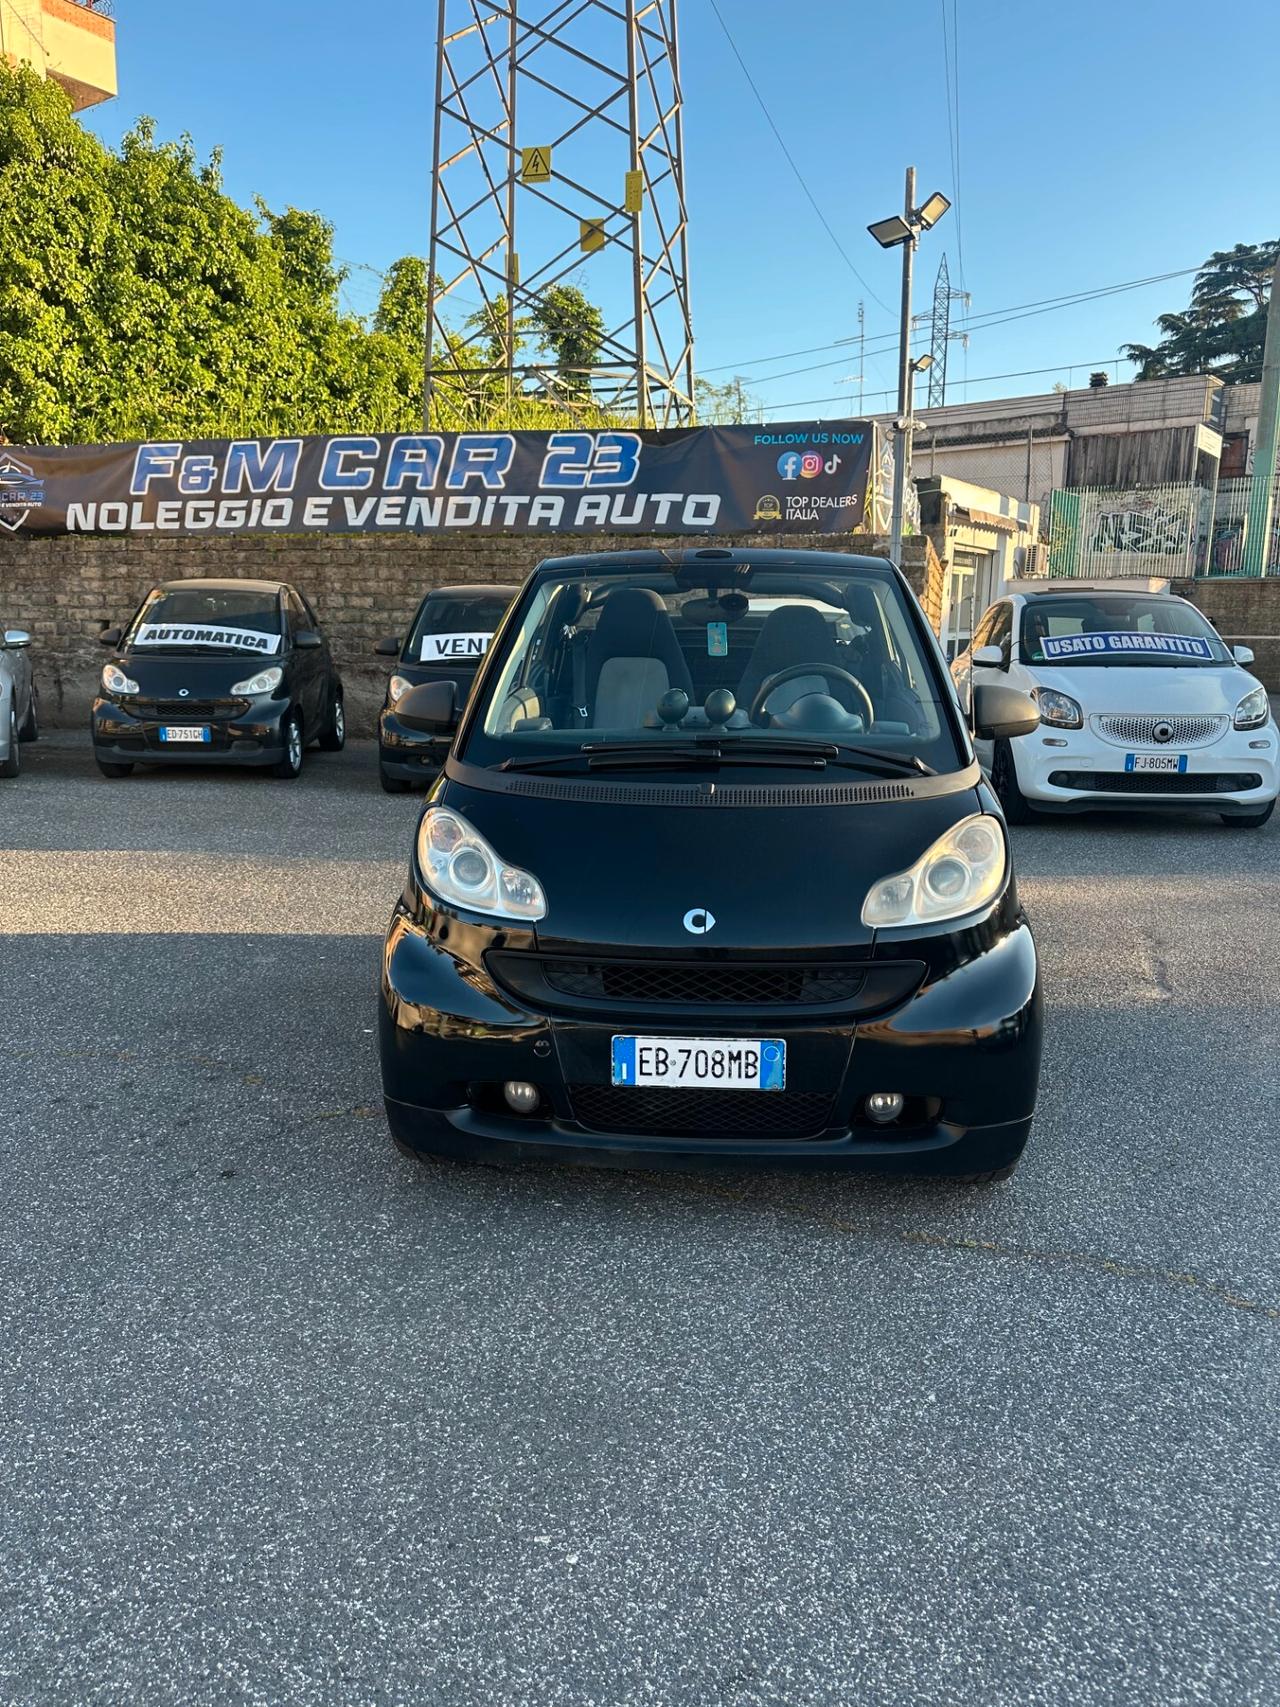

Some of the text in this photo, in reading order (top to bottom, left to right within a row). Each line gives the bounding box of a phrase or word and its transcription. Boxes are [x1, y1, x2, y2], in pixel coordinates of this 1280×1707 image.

[754, 433, 864, 445] FOLLOW US NOW
[130, 432, 642, 495] F&M CAR 23
[1, 491, 26, 501] CAR
[785, 494, 858, 508] TOP DEALERS
[66, 494, 721, 531] NOLEGGIO E VENDITA AUTO
[785, 509, 819, 520] ITALIA
[144, 629, 268, 649] AUTOMATICA
[1047, 635, 1205, 655] USATO GARANTITO
